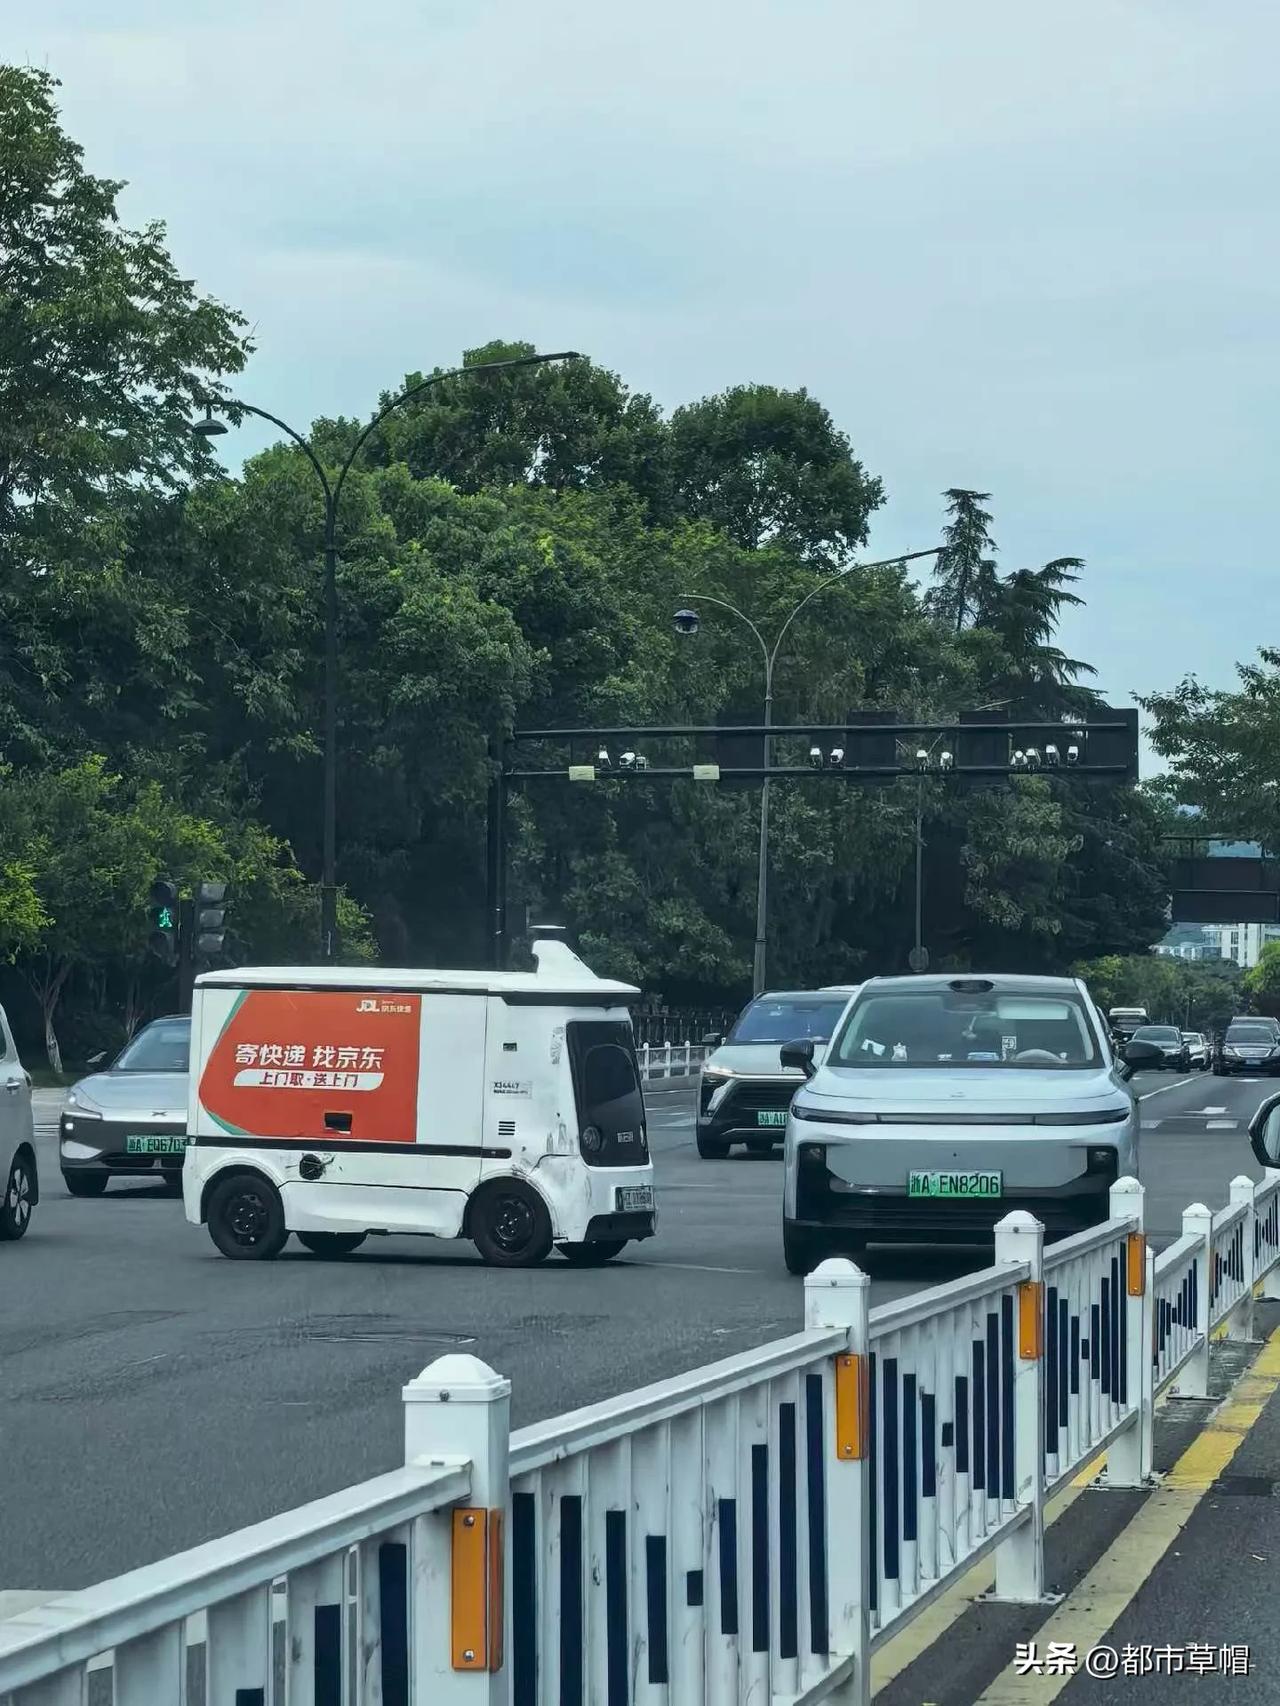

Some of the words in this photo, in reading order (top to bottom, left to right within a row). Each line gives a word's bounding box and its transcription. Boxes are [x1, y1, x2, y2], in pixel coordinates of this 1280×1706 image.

[356, 999, 380, 1012] JDL
[235, 1044, 306, 1067] 寄快递
[312, 1045, 384, 1069] 找京东
